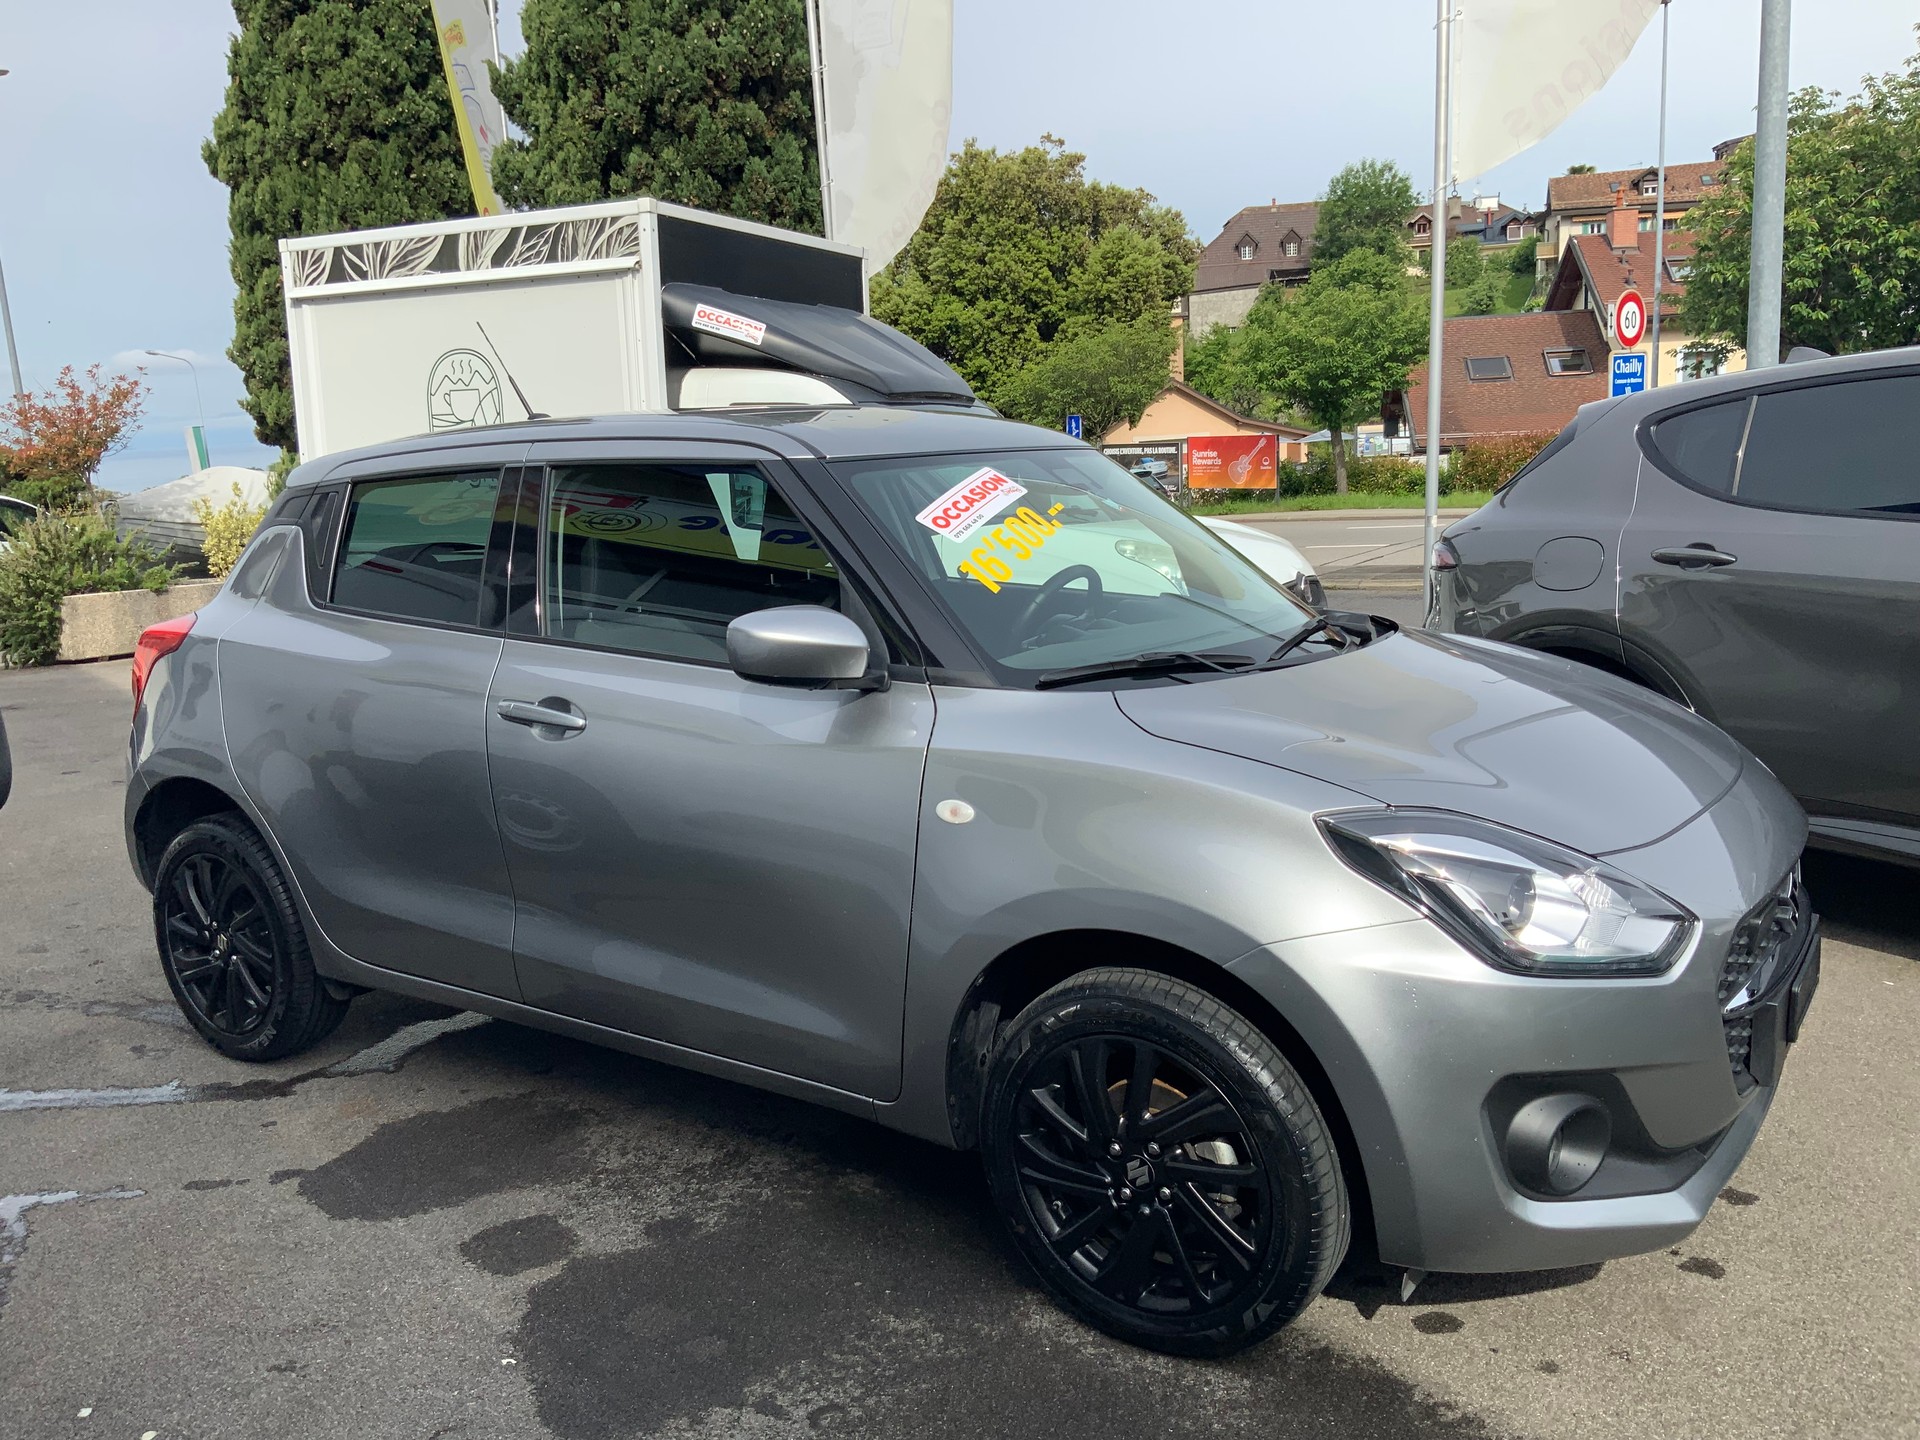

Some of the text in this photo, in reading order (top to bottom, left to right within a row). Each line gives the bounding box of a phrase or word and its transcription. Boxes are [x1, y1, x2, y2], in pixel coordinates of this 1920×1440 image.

[1625, 311, 1636, 330] 60
[1615, 358, 1642, 376] Chailly
[1192, 448, 1218, 458] Sunrise
[1192, 457, 1222, 465] Rewards
[931, 473, 1009, 529] OCCASION
[954, 530, 964, 538] 079
